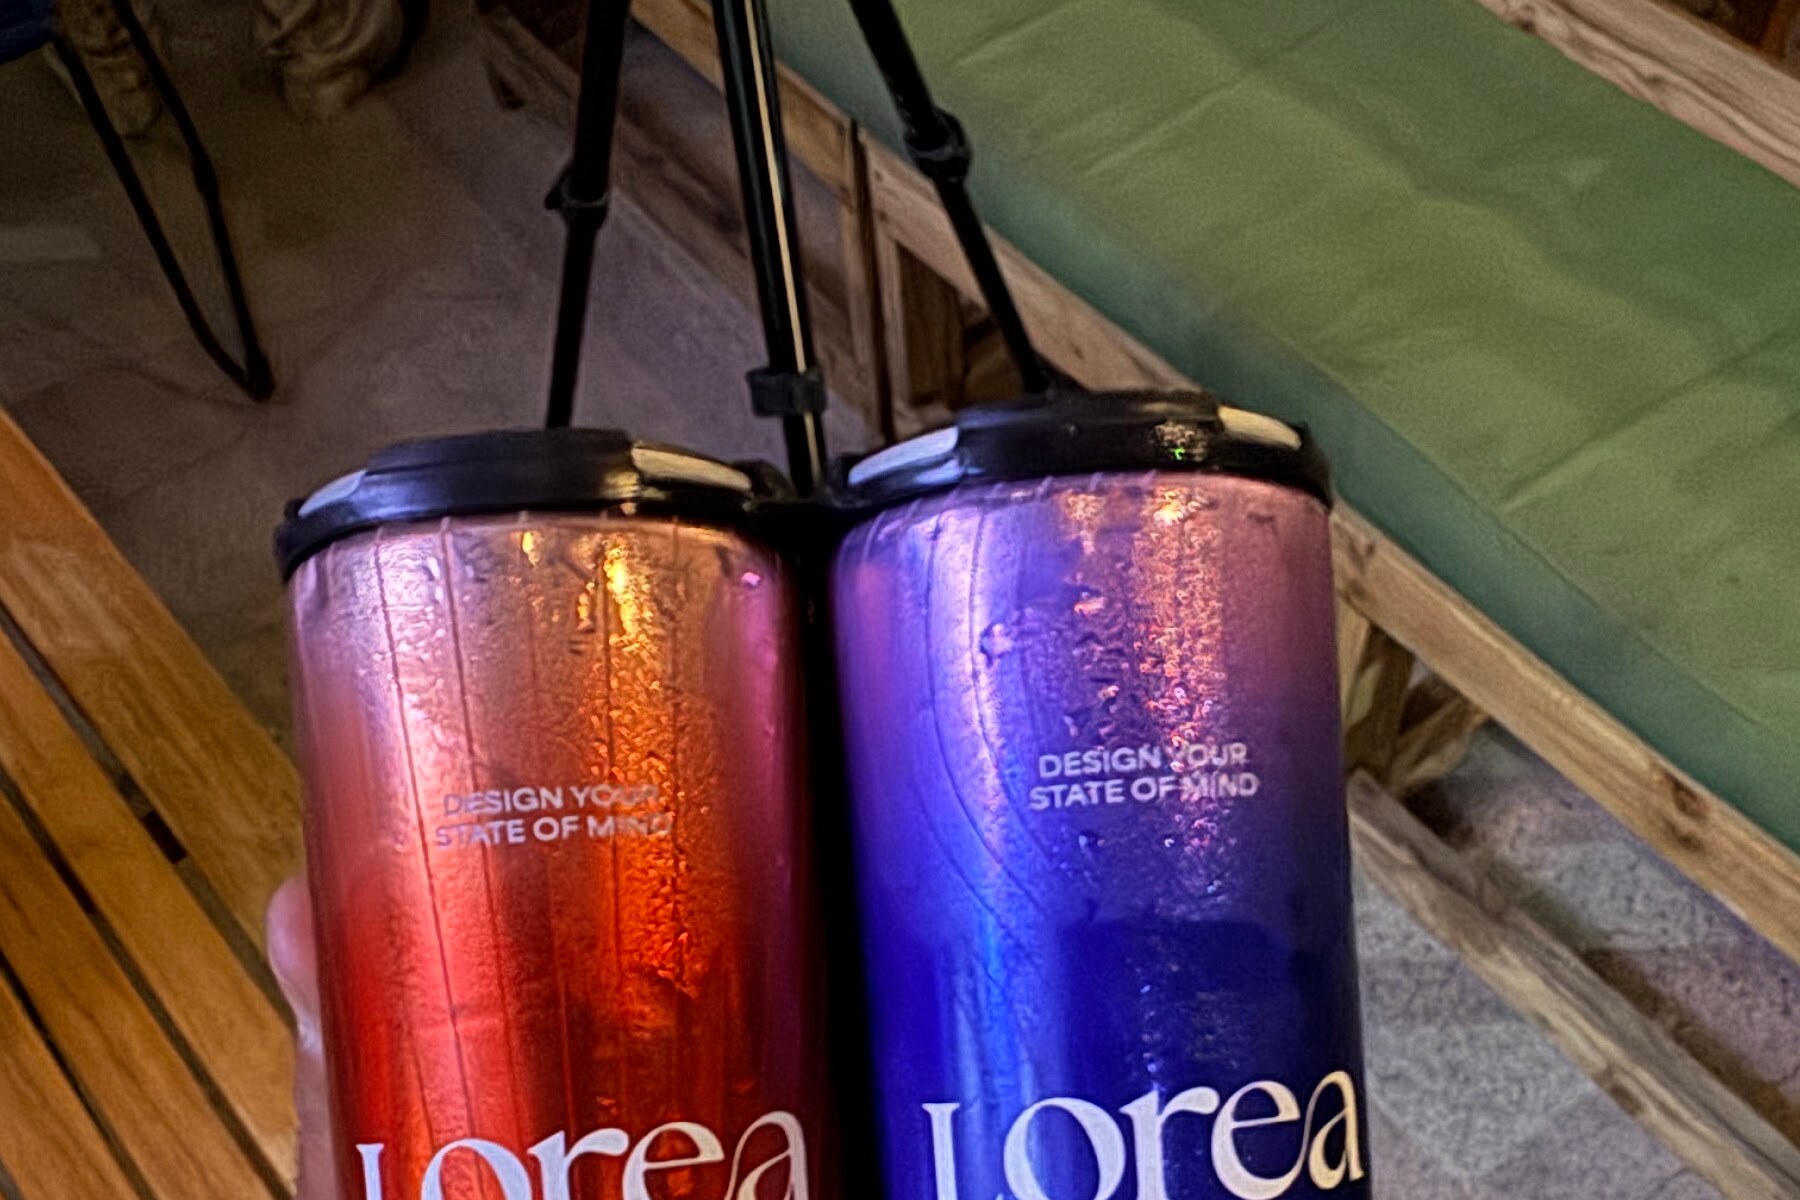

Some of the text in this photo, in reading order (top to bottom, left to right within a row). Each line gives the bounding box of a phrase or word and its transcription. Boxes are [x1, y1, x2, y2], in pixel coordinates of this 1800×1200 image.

[1039, 744, 1162, 778] DESIGN
[444, 786, 563, 815] DESIGN
[1029, 772, 1259, 811] STATE OF MIND
[436, 819, 526, 847] STATE
[533, 816, 579, 841] OF
